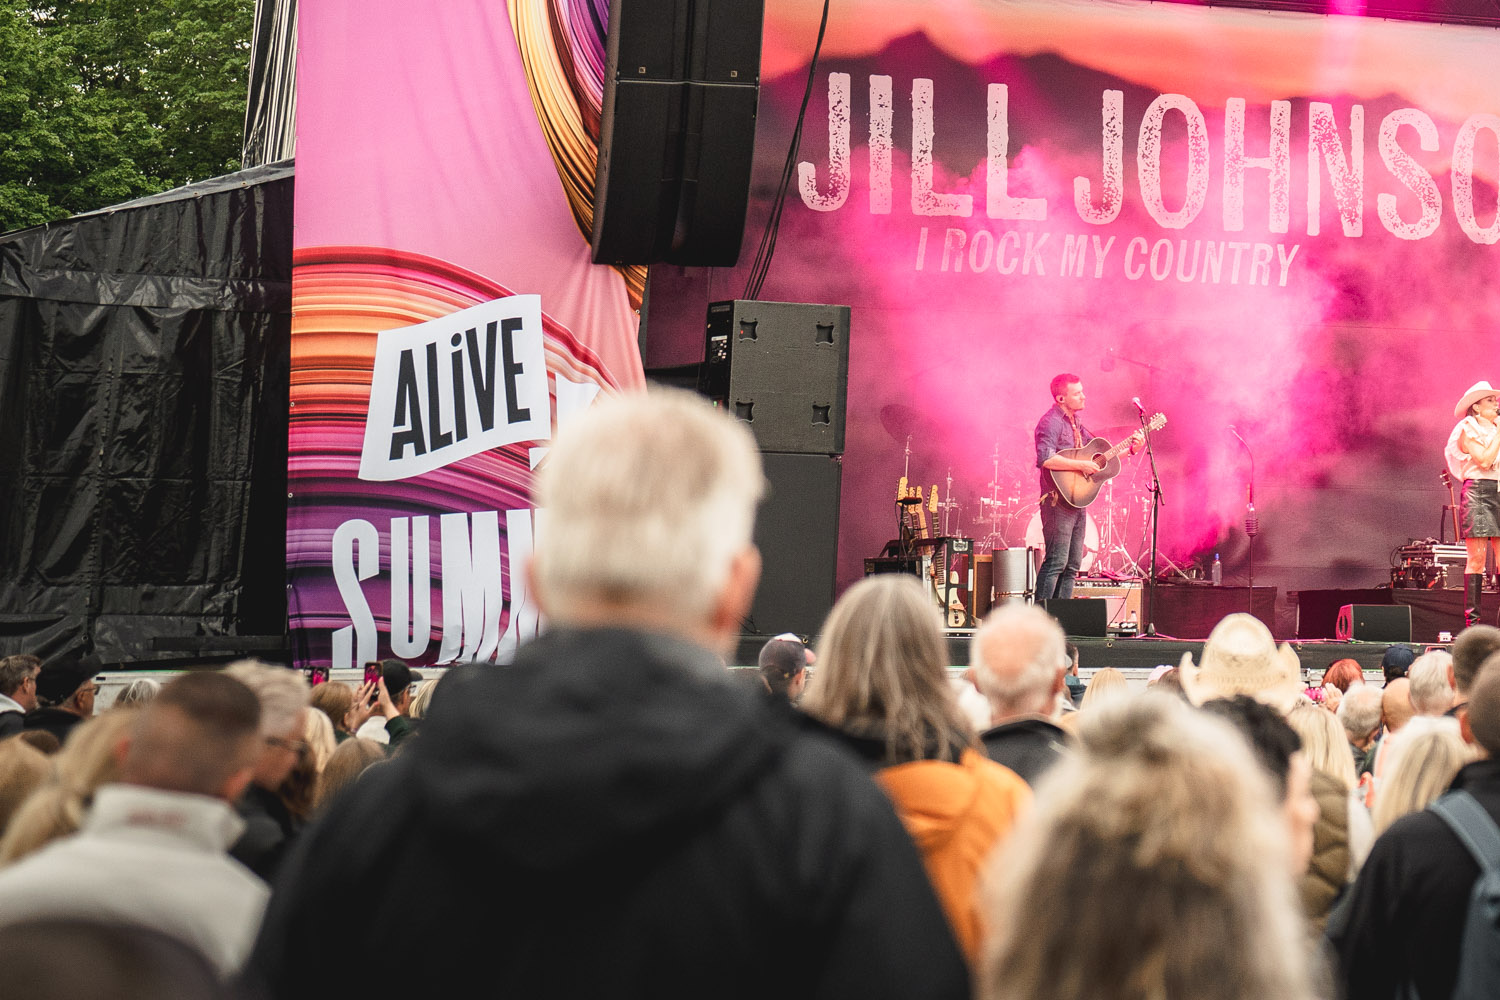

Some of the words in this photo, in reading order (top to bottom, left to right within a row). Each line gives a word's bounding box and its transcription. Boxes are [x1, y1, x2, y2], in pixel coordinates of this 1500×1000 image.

[798, 72, 1047, 221] JILL
[915, 227, 929, 272] I
[940, 228, 1051, 275] ROCK
[1060, 234, 1117, 279] MY
[1124, 236, 1300, 287] COUNTRY
